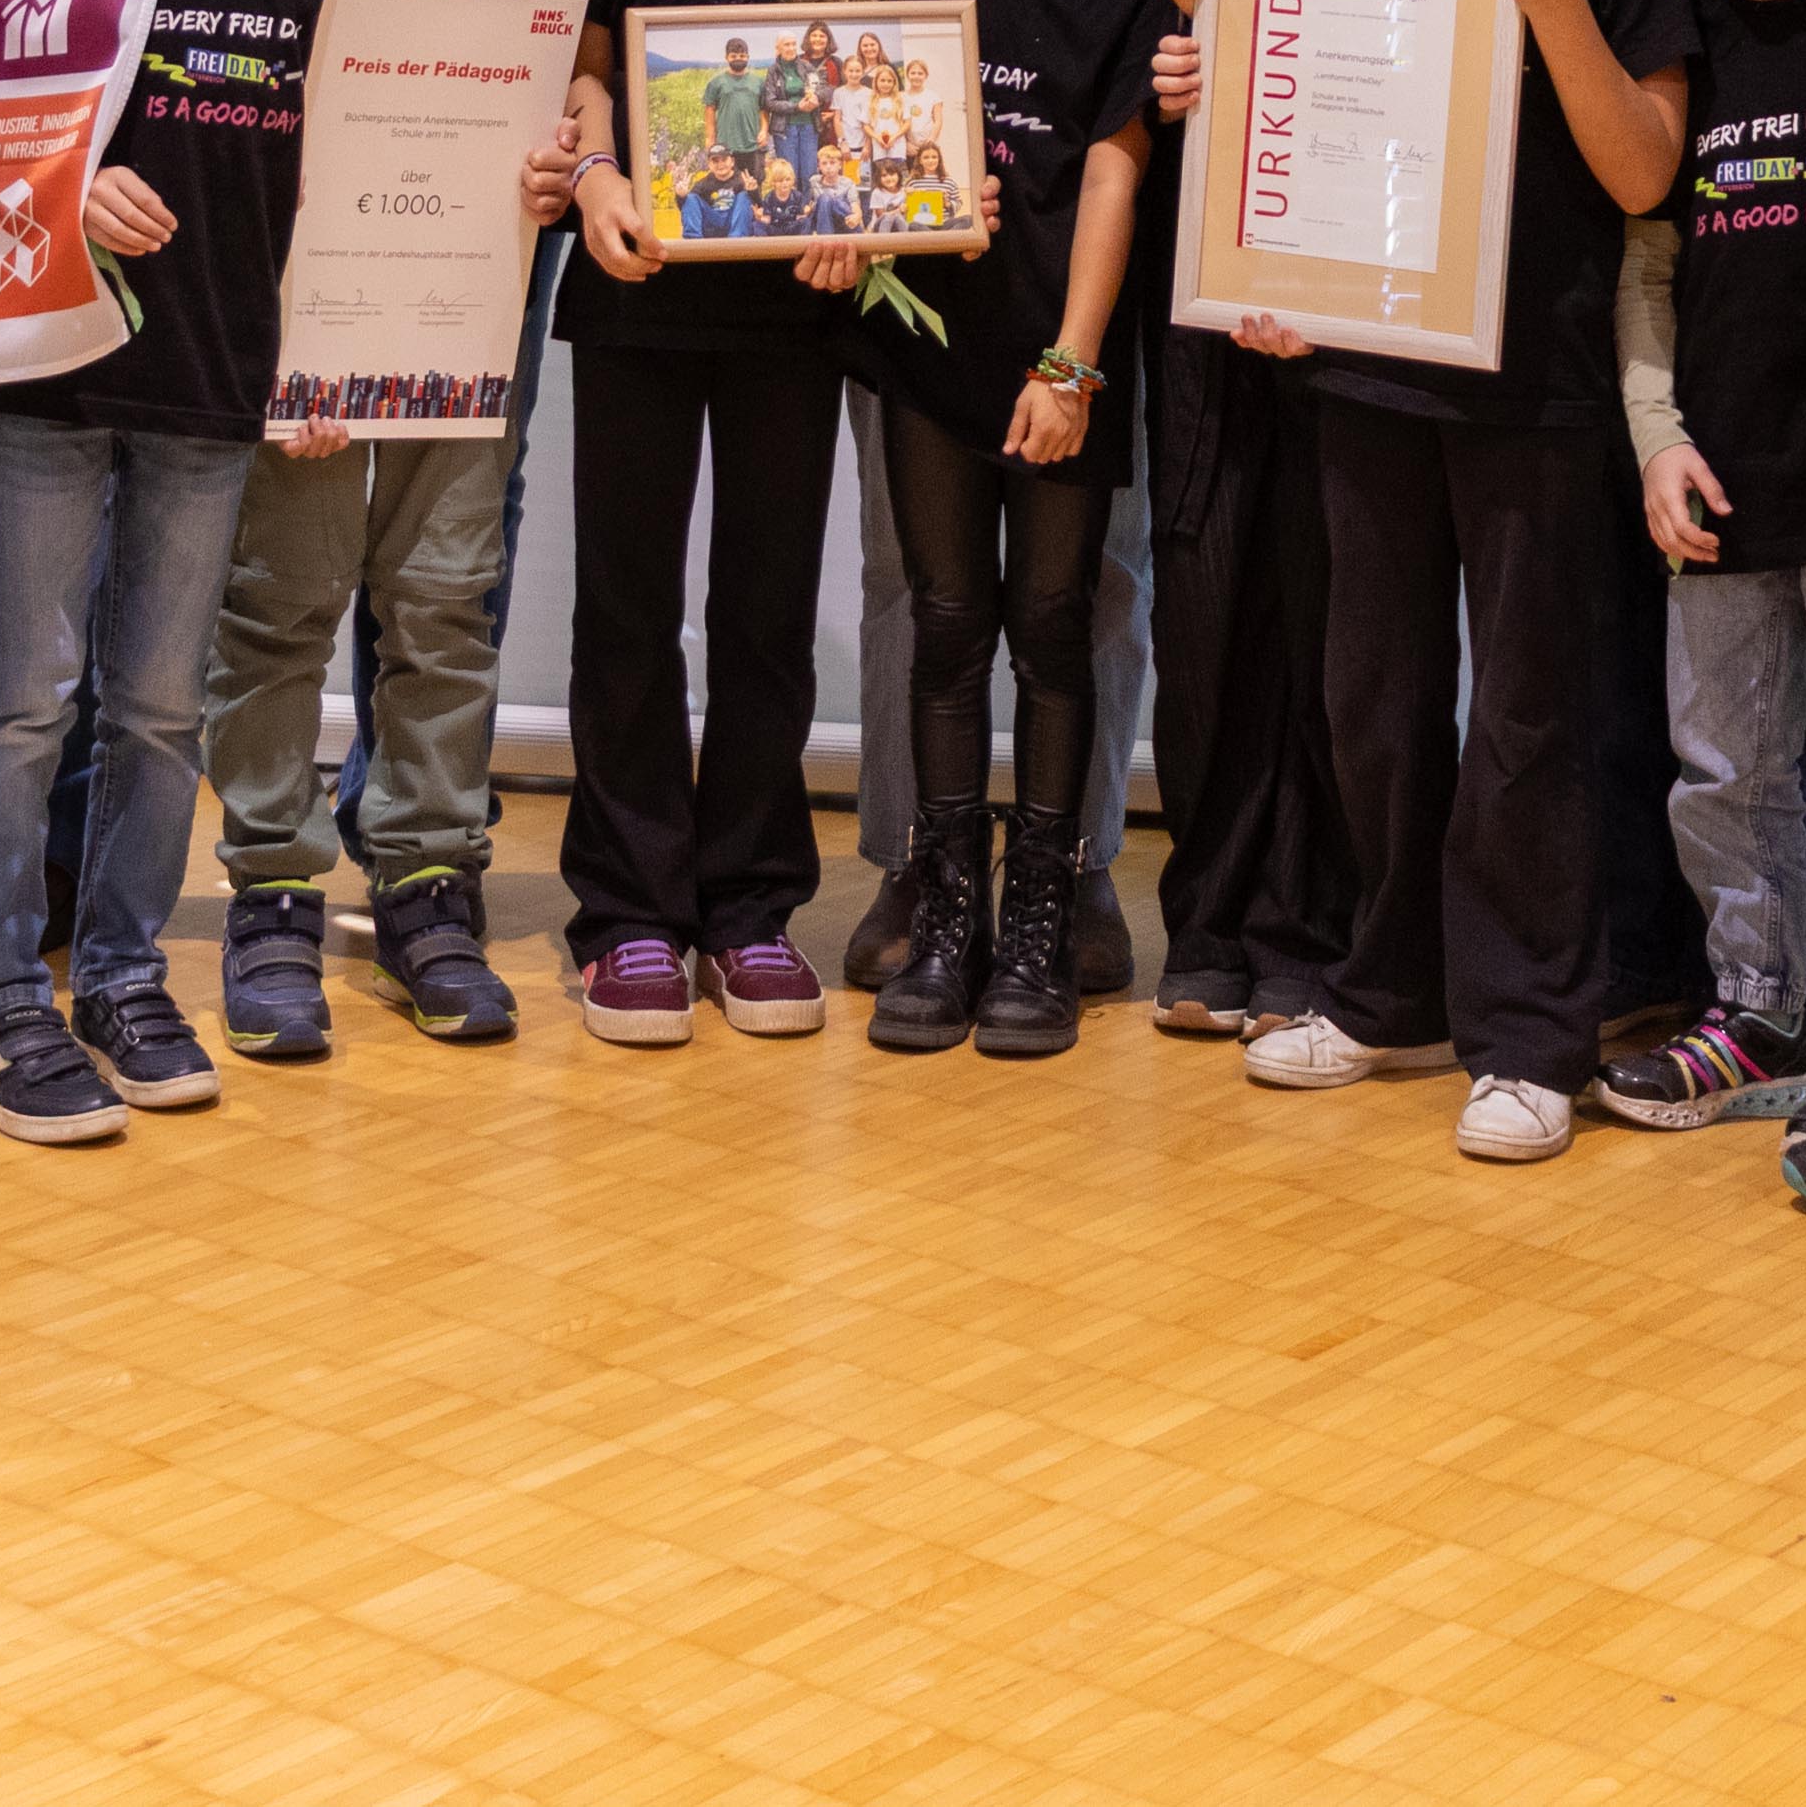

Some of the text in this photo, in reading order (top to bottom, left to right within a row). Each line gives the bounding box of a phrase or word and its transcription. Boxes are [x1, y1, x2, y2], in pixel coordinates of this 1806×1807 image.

[153, 9, 223, 34] EVERY
[229, 12, 274, 38] FREI
[533, 10, 568, 22] INNS'
[530, 22, 574, 35] BRUCK
[343, 57, 532, 84] Preis der Pädagogik
[993, 65, 1038, 92] DAY
[146, 95, 302, 134] IS A GOOD DAY
[344, 112, 509, 128] Büchergutschein Anerkennungspreis
[391, 128, 424, 138] Schule
[1696, 121, 1746, 157] EVERY
[1752, 113, 1798, 142] FREI
[400, 170, 432, 183] über
[357, 193, 373, 213] €
[1713, 210, 1728, 235] A
[1733, 204, 1799, 230] GOOD
[351, 250, 366, 258] von
[367, 249, 381, 258] der
